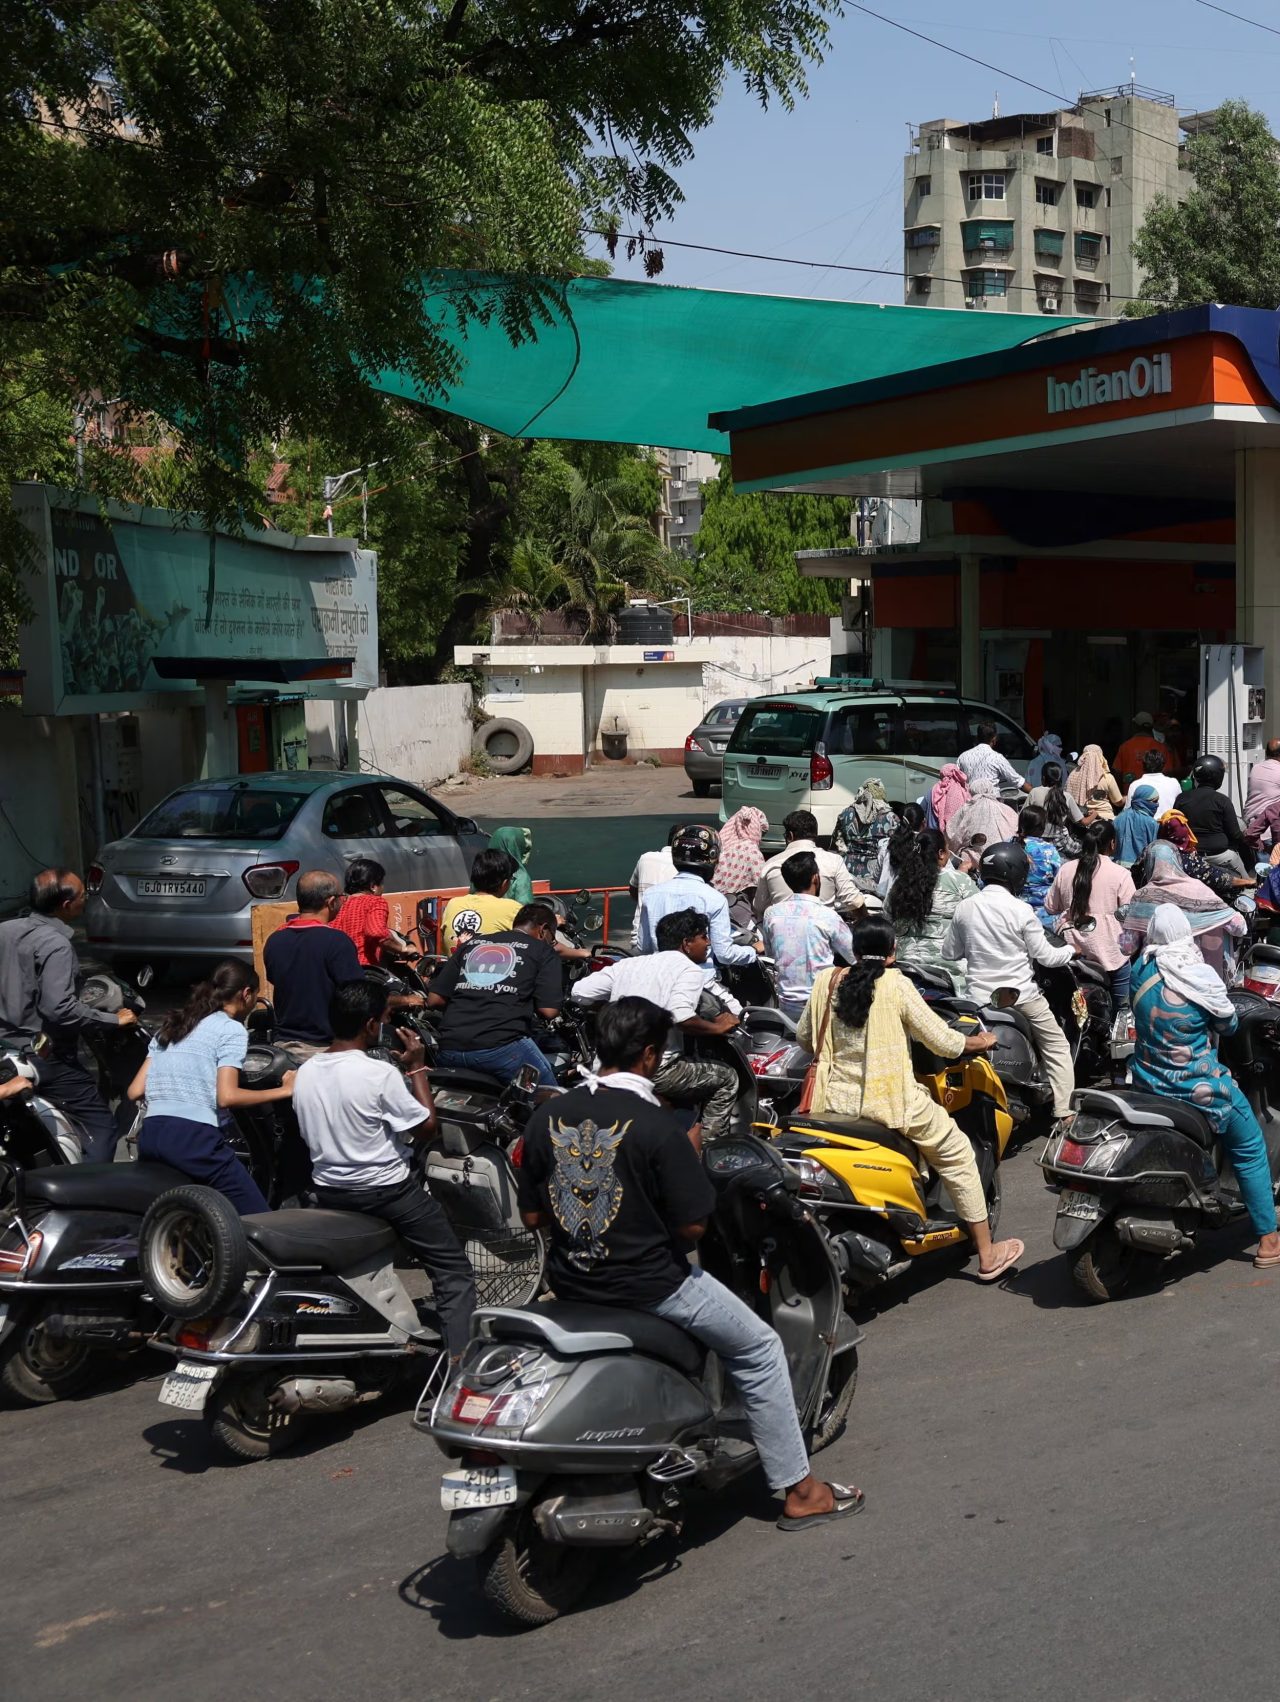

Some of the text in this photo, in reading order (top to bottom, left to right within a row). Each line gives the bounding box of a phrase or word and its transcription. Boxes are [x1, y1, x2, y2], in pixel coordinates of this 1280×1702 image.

[1047, 352, 1172, 414] IndianOil
[144, 881, 204, 894] GJ01RV5440
[576, 1427, 646, 1442] Jupiter
[454, 1484, 511, 1508] FZ4976
